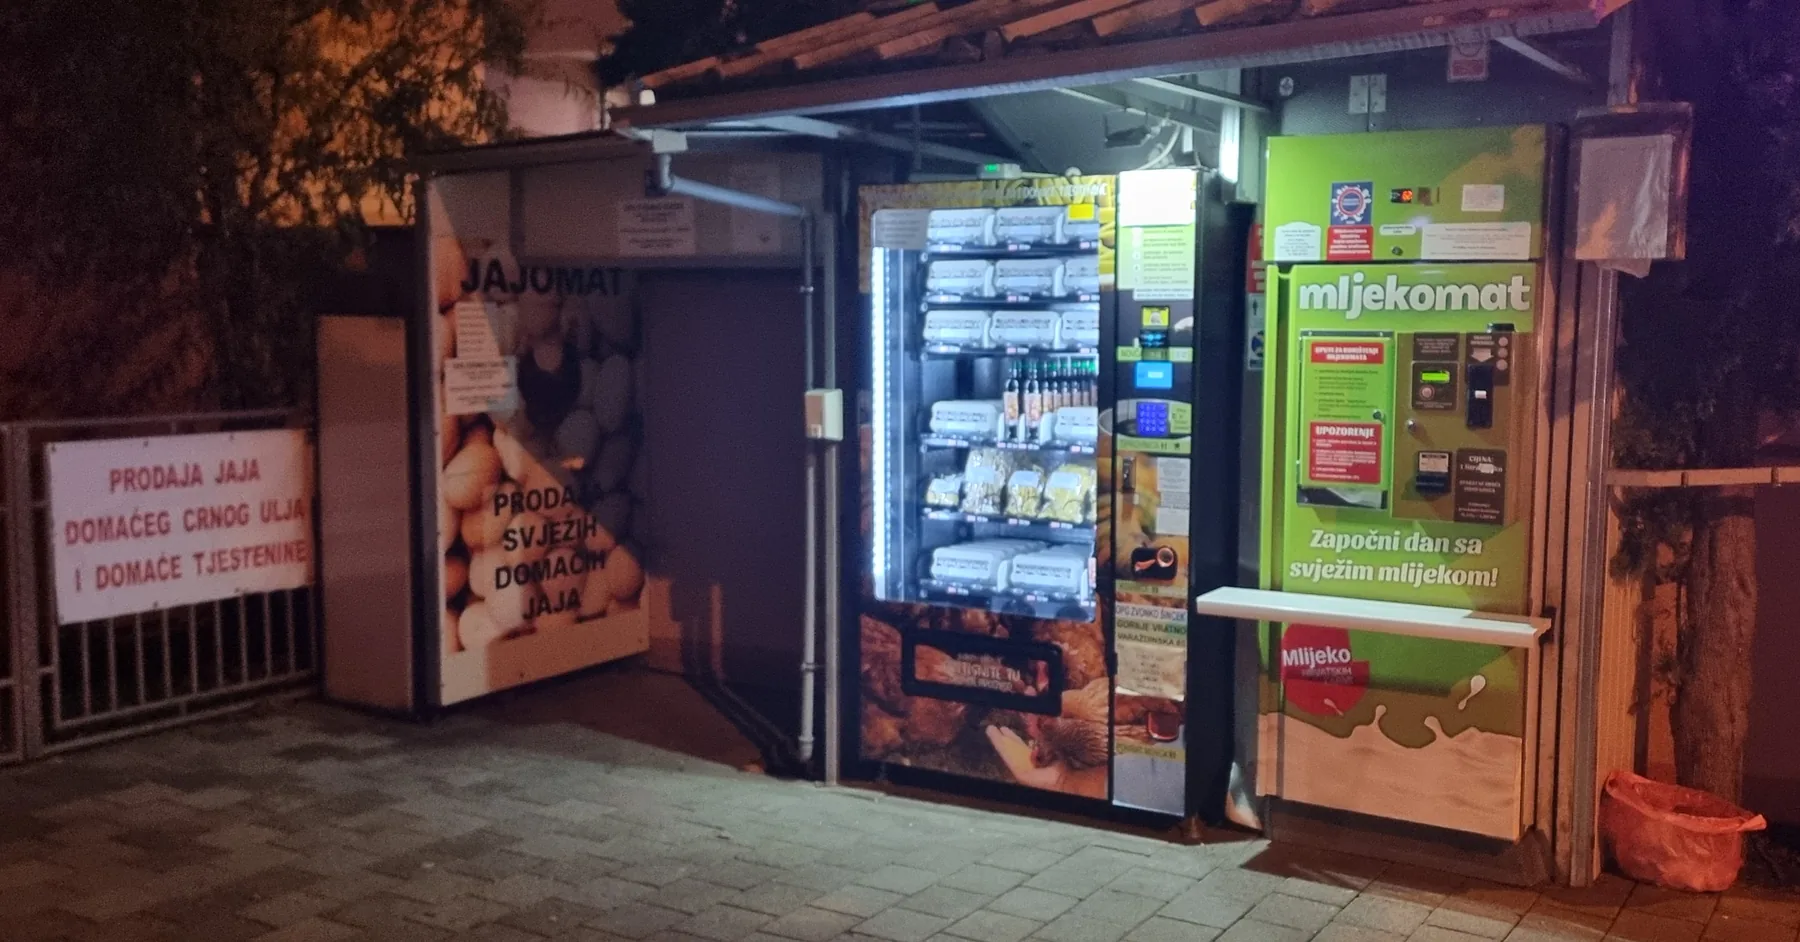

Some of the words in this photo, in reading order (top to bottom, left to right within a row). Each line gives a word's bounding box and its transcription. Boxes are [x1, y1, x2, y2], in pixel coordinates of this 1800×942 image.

[461, 256, 624, 297] JAJOMAT
[1299, 271, 1531, 320] mljekomat
[1315, 425, 1375, 439] UPOZORENJE
[109, 464, 203, 494] PRODAJA
[214, 457, 261, 485] JAJA
[64, 507, 171, 546] DOMAĆEG
[182, 503, 251, 533] CRNOG
[259, 498, 306, 524] ULJA
[502, 510, 598, 552] SVJEŽIH
[1310, 529, 1400, 553] Započni
[1404, 532, 1450, 553] dan
[1453, 538, 1483, 555] sa
[75, 568, 81, 593] I
[96, 553, 183, 592] DOMAĆE
[193, 538, 309, 575] TJESTENINE
[1289, 559, 1374, 583] svježim
[1378, 562, 1499, 588] mlijekom!
[521, 586, 582, 620] JAJA
[1281, 645, 1352, 669] Mlijeko
